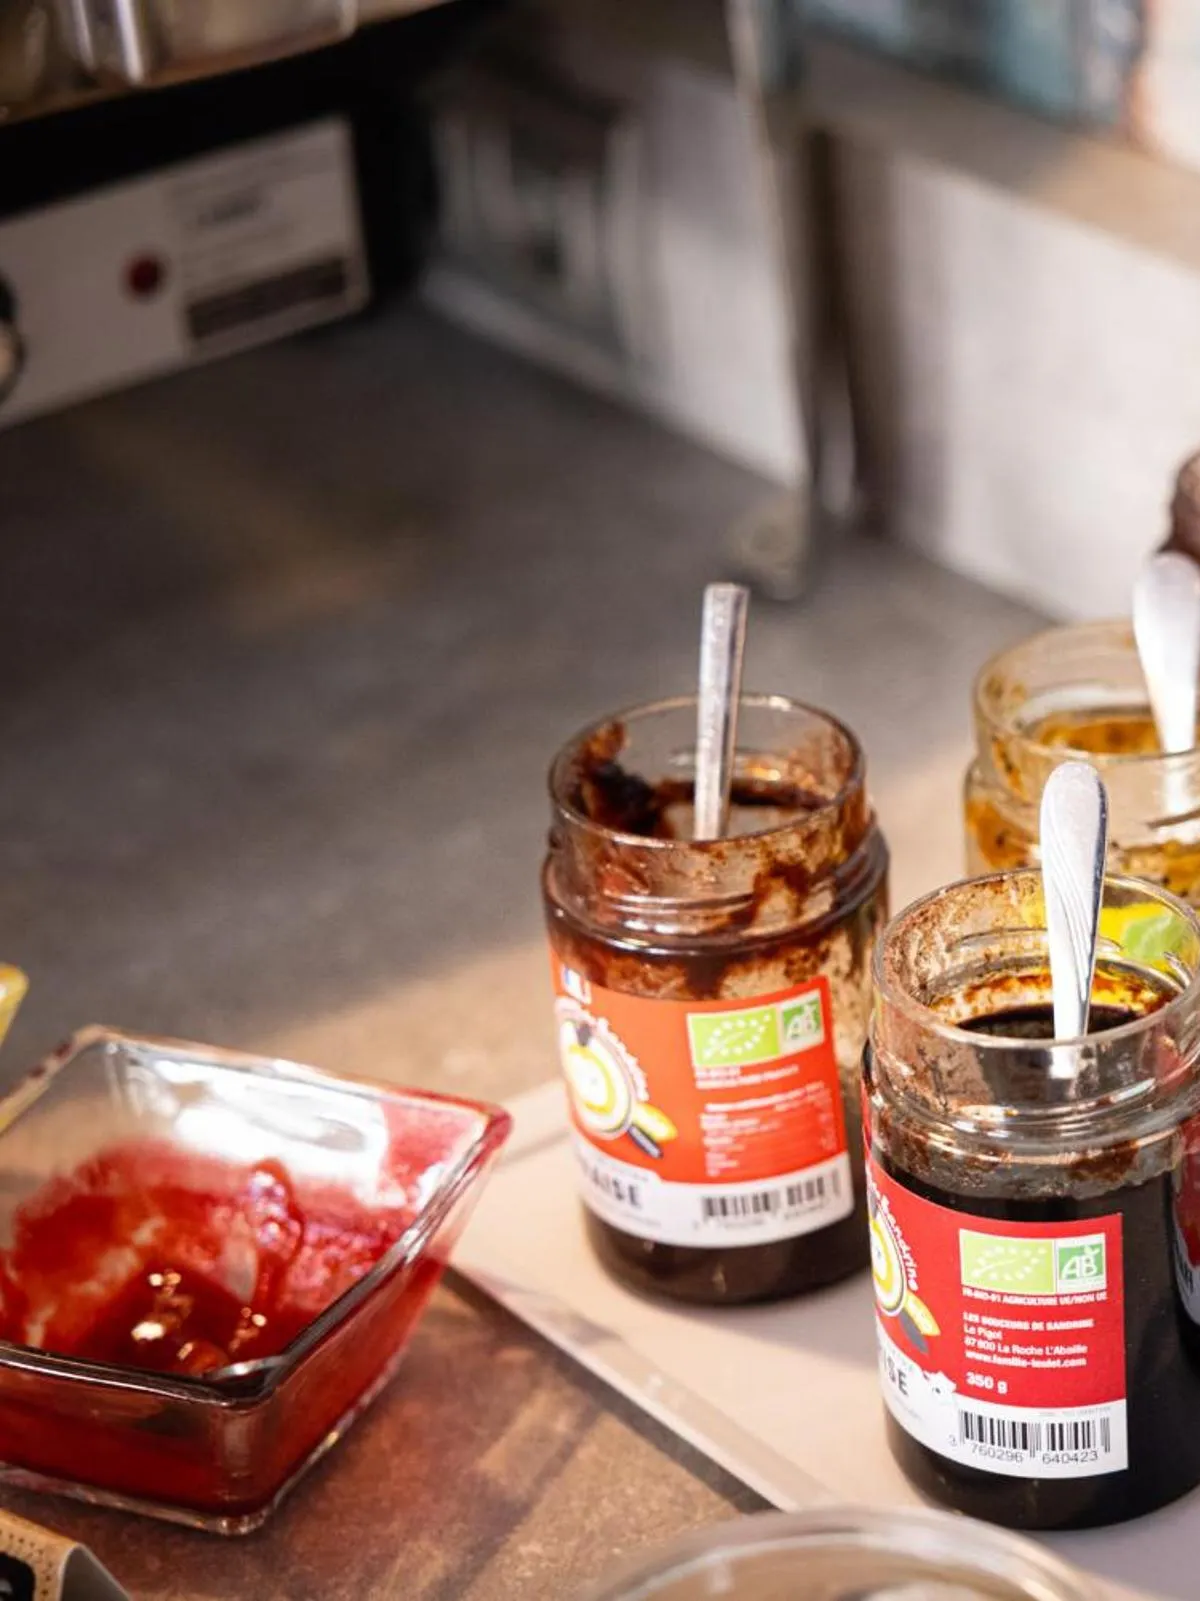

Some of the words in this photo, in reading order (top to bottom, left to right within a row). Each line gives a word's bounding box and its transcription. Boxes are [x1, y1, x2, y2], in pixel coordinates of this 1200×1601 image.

[1061, 1250, 1098, 1280] AB
[1012, 1345, 1043, 1355] Roche
[966, 1372, 994, 1389] 350
[997, 1381, 1007, 1394] g
[949, 1435, 958, 1447] 3
[971, 1443, 1023, 1463] 760296
[1042, 1450, 1098, 1465] 640423
